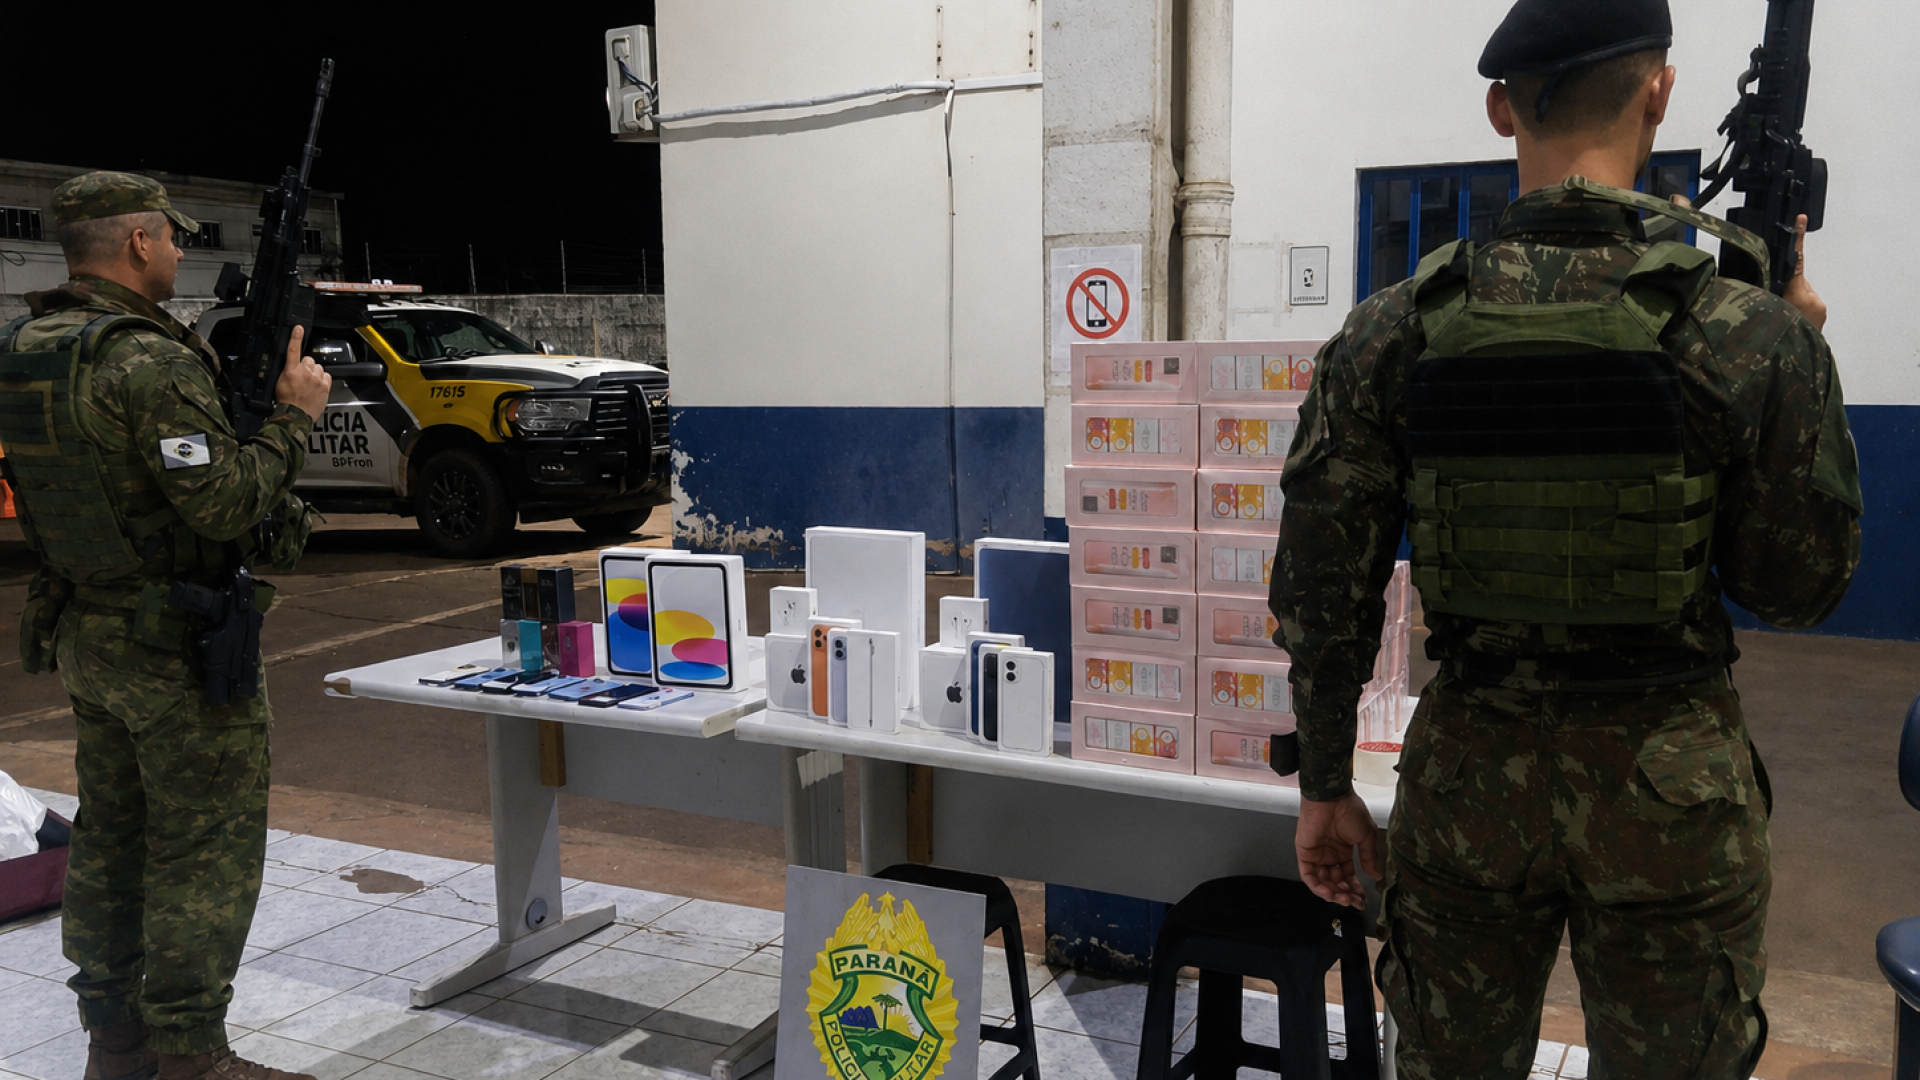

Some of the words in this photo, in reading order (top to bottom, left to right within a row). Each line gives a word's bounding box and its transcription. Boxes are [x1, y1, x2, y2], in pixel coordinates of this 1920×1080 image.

[430, 385, 466, 398] 17615
[313, 406, 367, 433] LÍCIA
[307, 434, 371, 454] LITAR
[332, 457, 374, 468] BPFron
[834, 953, 931, 989] PARANÁ
[826, 1021, 862, 1080] POLICI
